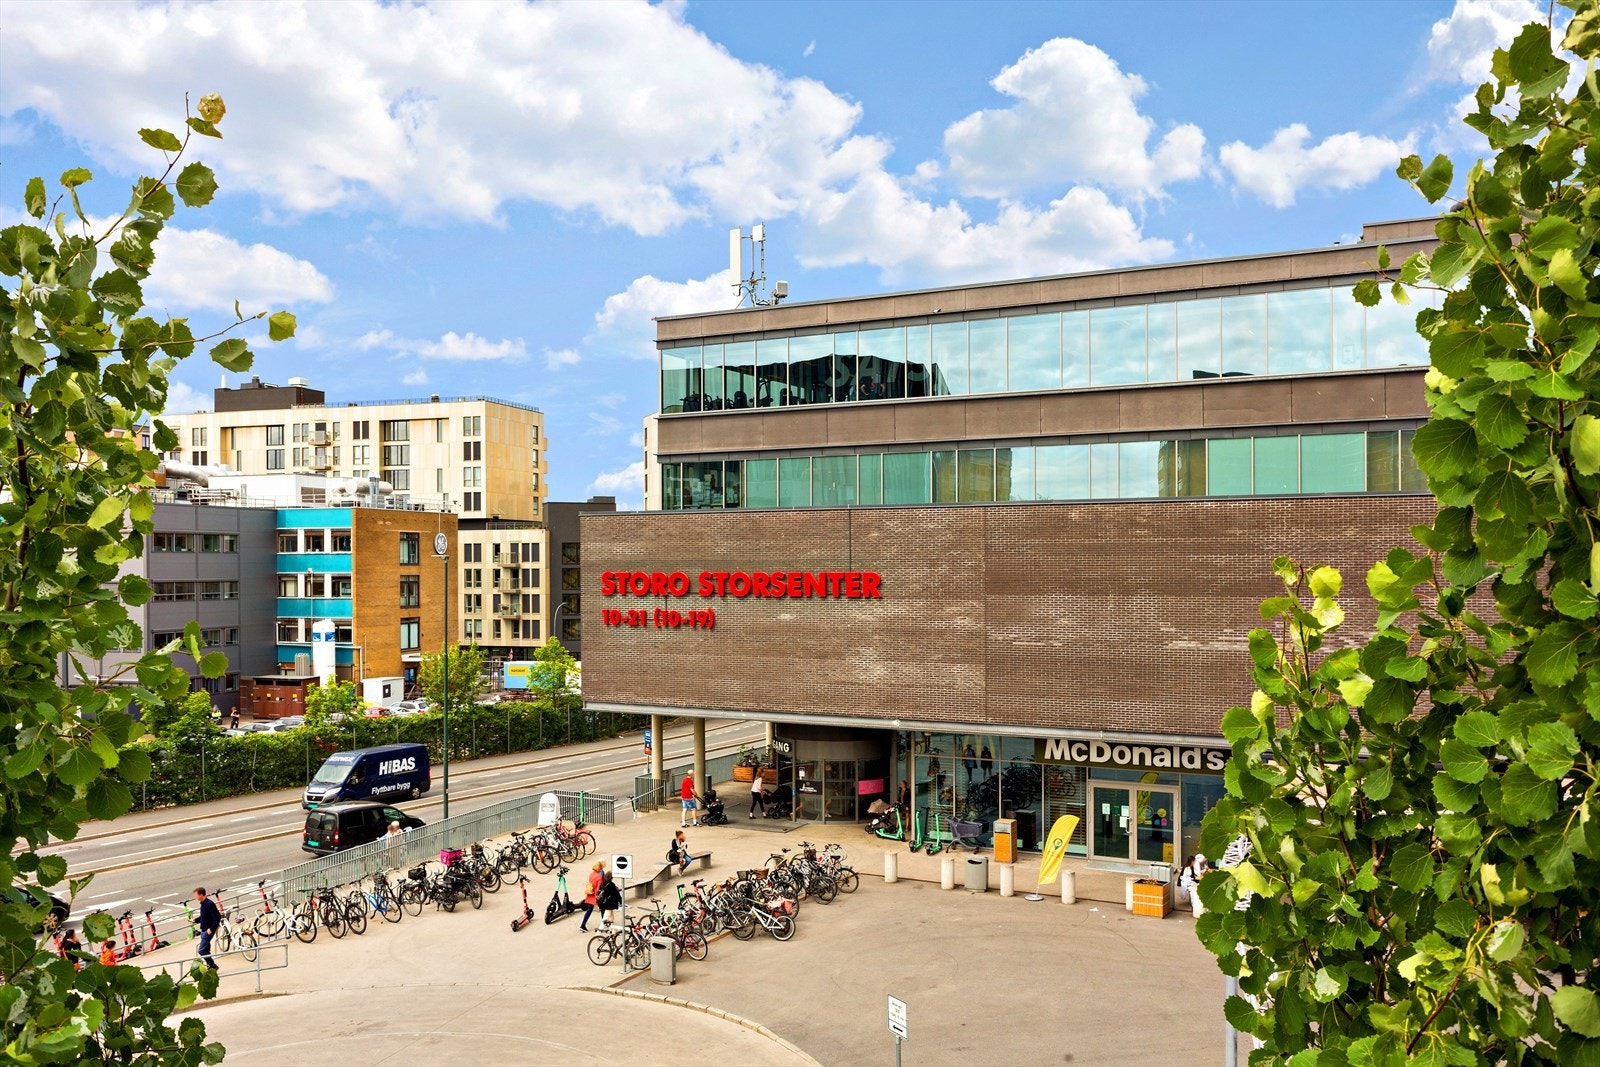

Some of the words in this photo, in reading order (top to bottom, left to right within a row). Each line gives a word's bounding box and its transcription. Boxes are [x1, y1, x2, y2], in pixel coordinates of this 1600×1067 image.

[600, 570, 690, 597] STORO
[697, 571, 882, 598] STORSENTER
[601, 609, 647, 627] 10-21
[653, 607, 715, 629] (10-19)
[1044, 737, 1225, 771] McDonald's
[371, 784, 396, 796] Flyttbare
